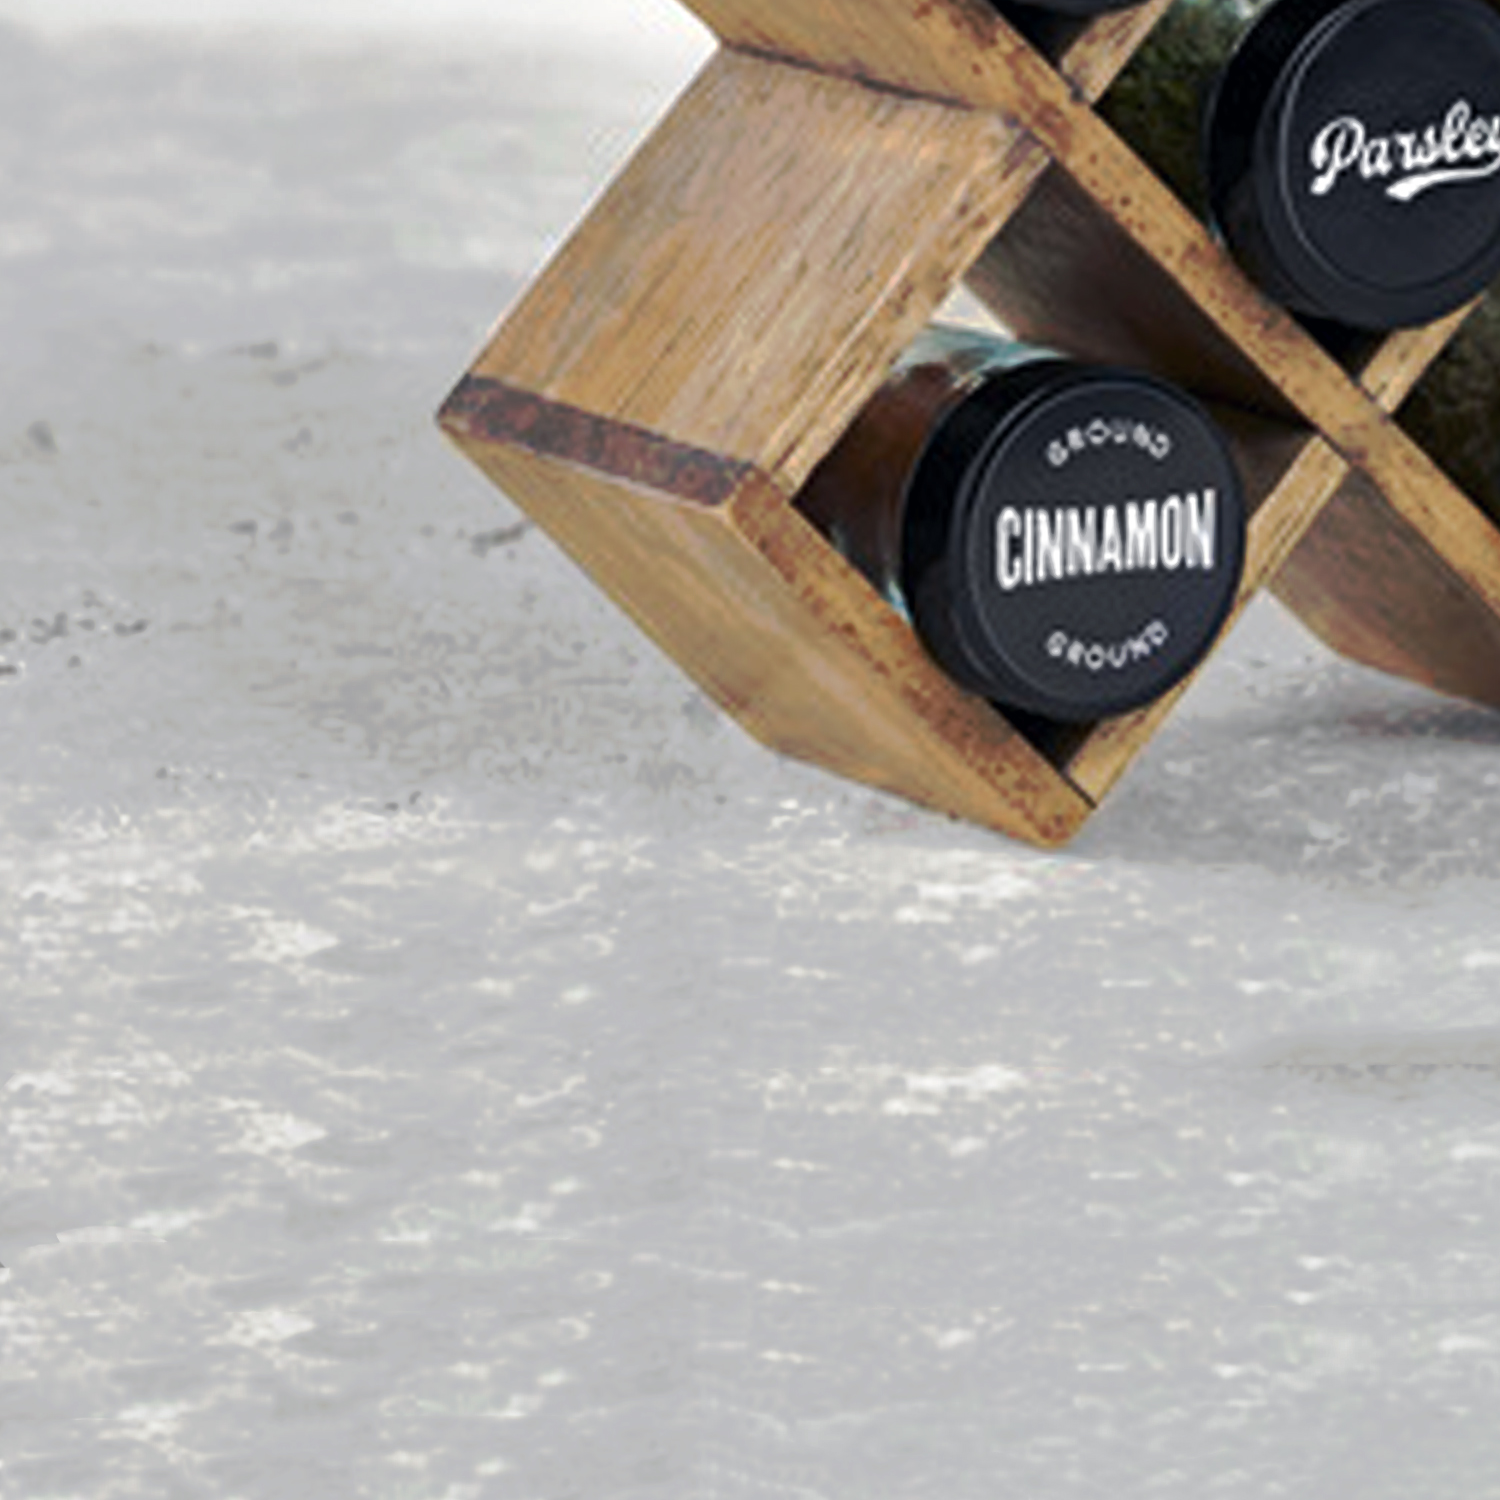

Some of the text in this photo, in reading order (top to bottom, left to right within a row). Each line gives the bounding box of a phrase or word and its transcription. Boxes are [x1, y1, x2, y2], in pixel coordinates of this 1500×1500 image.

[1047, 418, 1171, 467] GROUND
[996, 488, 1217, 591] CINNAMON
[1046, 620, 1169, 671] GROUND
